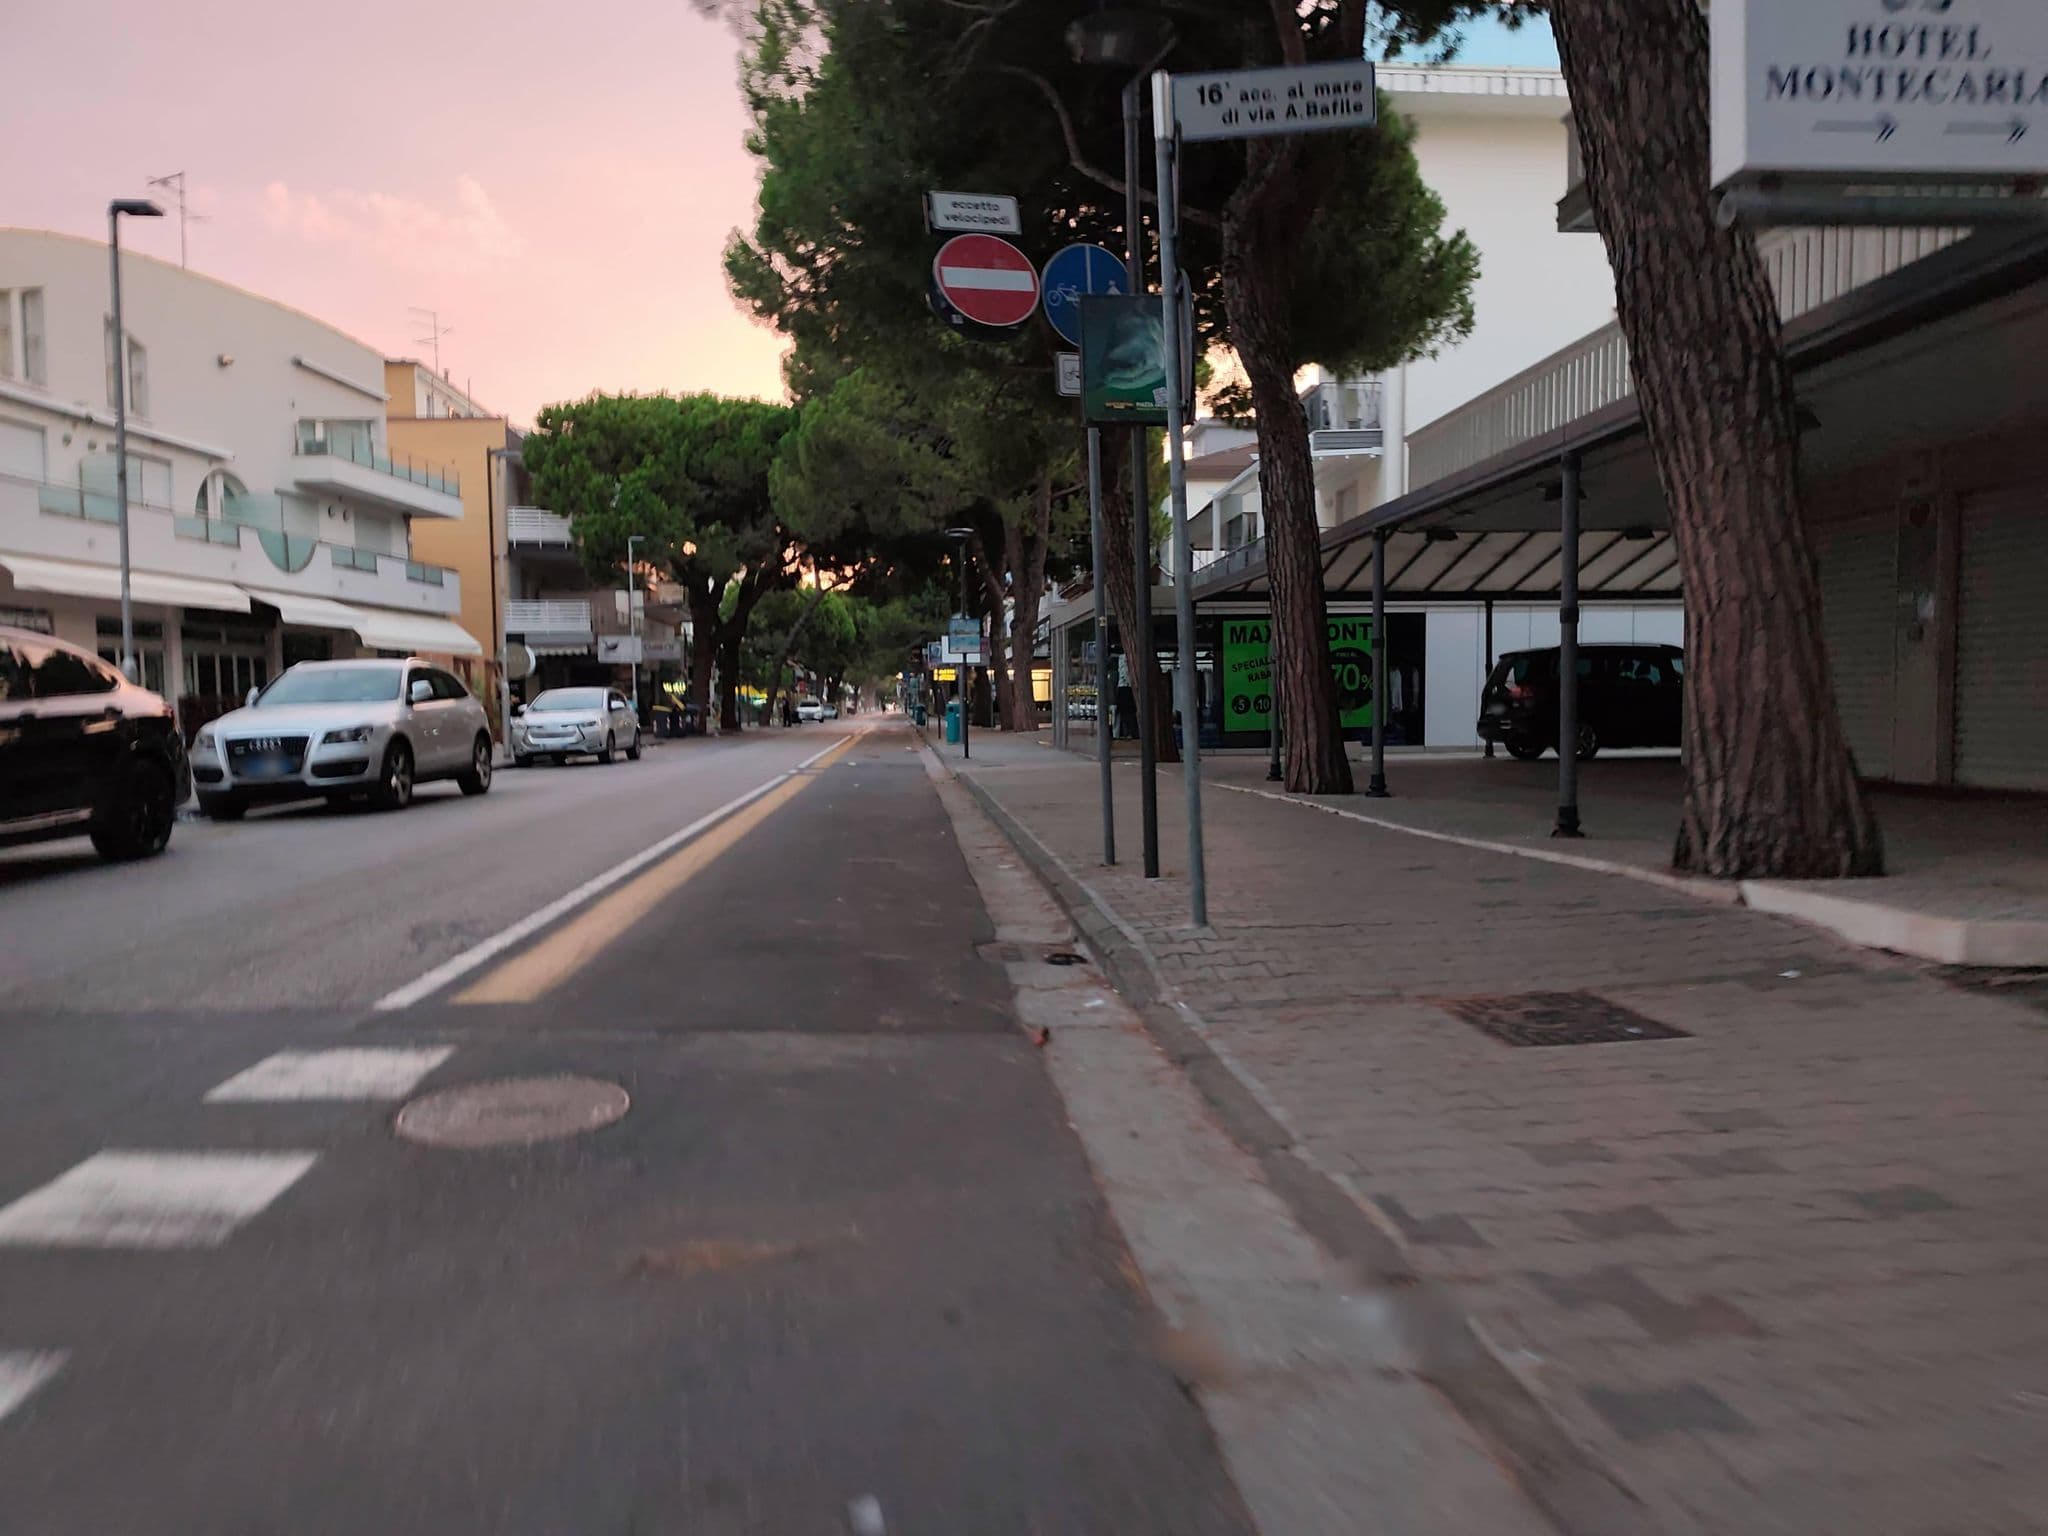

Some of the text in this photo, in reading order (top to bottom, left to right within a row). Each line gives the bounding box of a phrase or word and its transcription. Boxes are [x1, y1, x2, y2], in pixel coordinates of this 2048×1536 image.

[1847, 24, 1992, 60] HOTEL
[1287, 80, 1304, 99] al
[1314, 80, 1363, 96] mare
[1766, 64, 2048, 102] MONTECARL
[1222, 107, 1239, 125] di
[1248, 106, 1275, 122] via
[951, 200, 1000, 213] eccetto
[944, 212, 1011, 226] velocipedi
